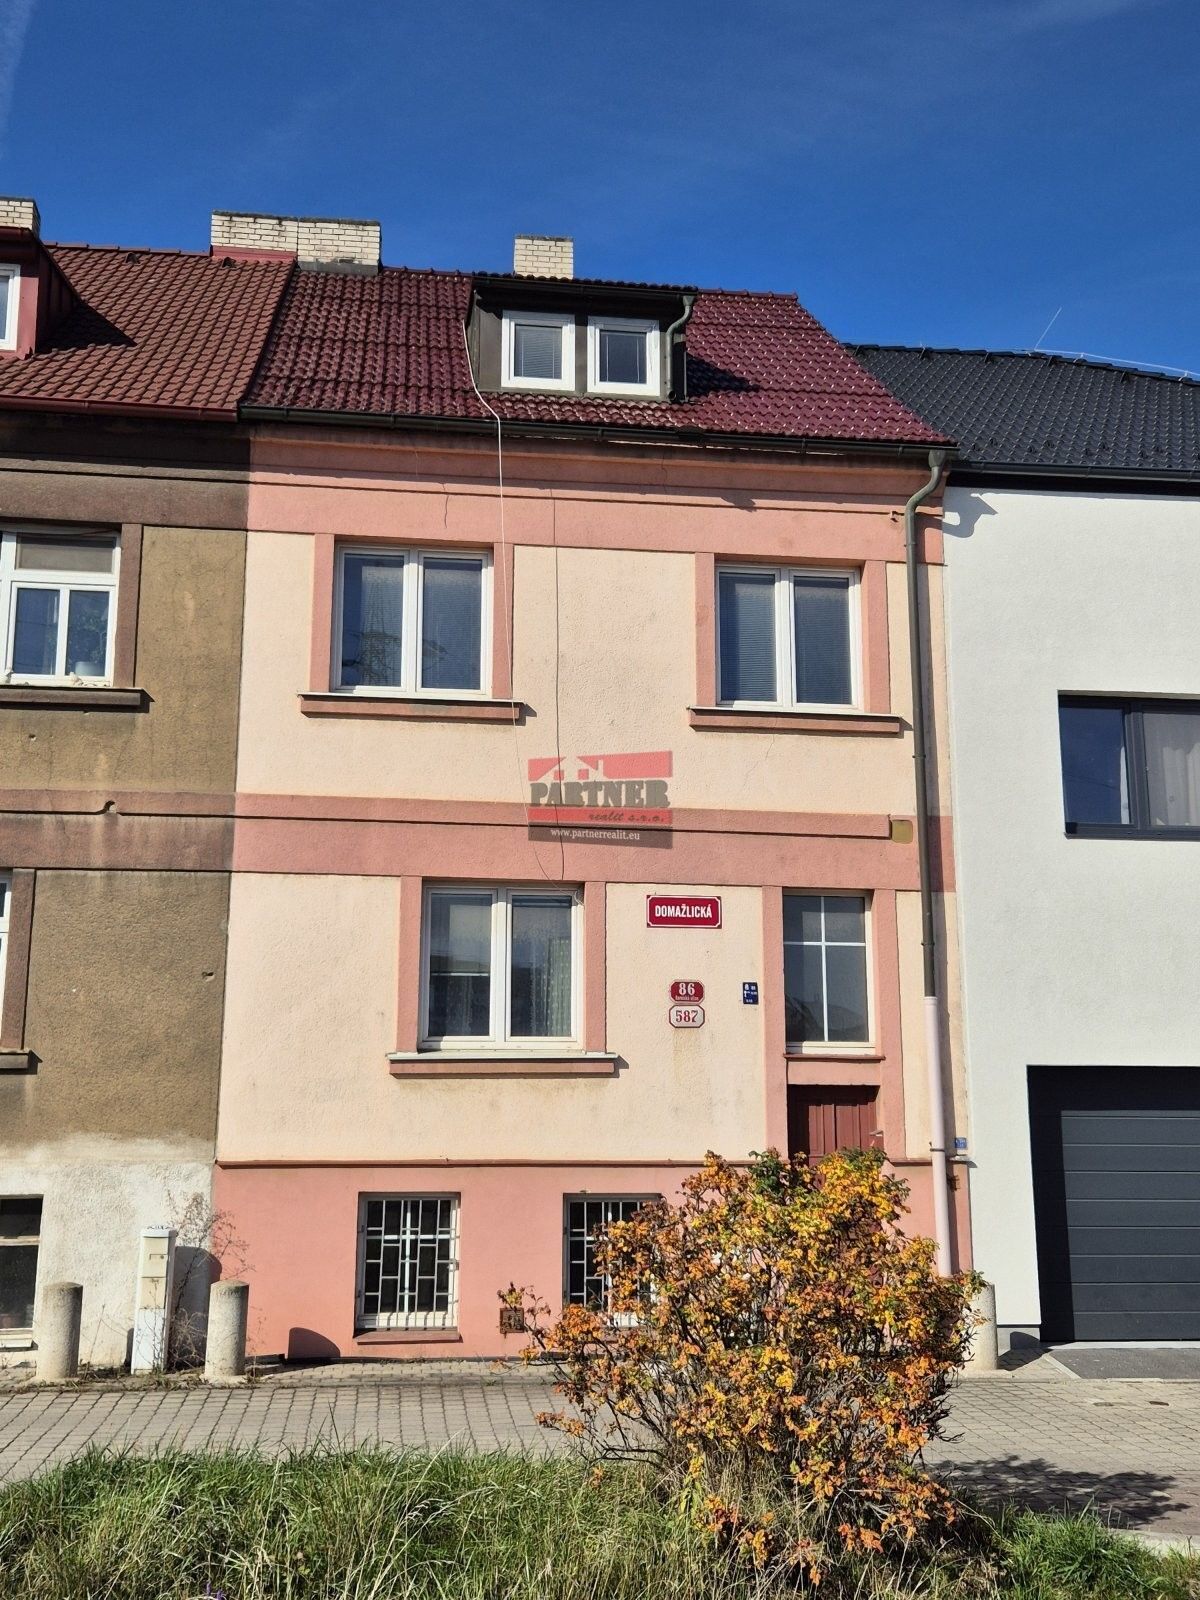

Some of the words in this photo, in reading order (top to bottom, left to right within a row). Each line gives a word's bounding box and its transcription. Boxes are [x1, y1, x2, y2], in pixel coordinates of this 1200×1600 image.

[655, 904, 713, 918] DOMAŽLICKÁ
[679, 982, 696, 996] 86
[675, 1010, 699, 1023] 587
